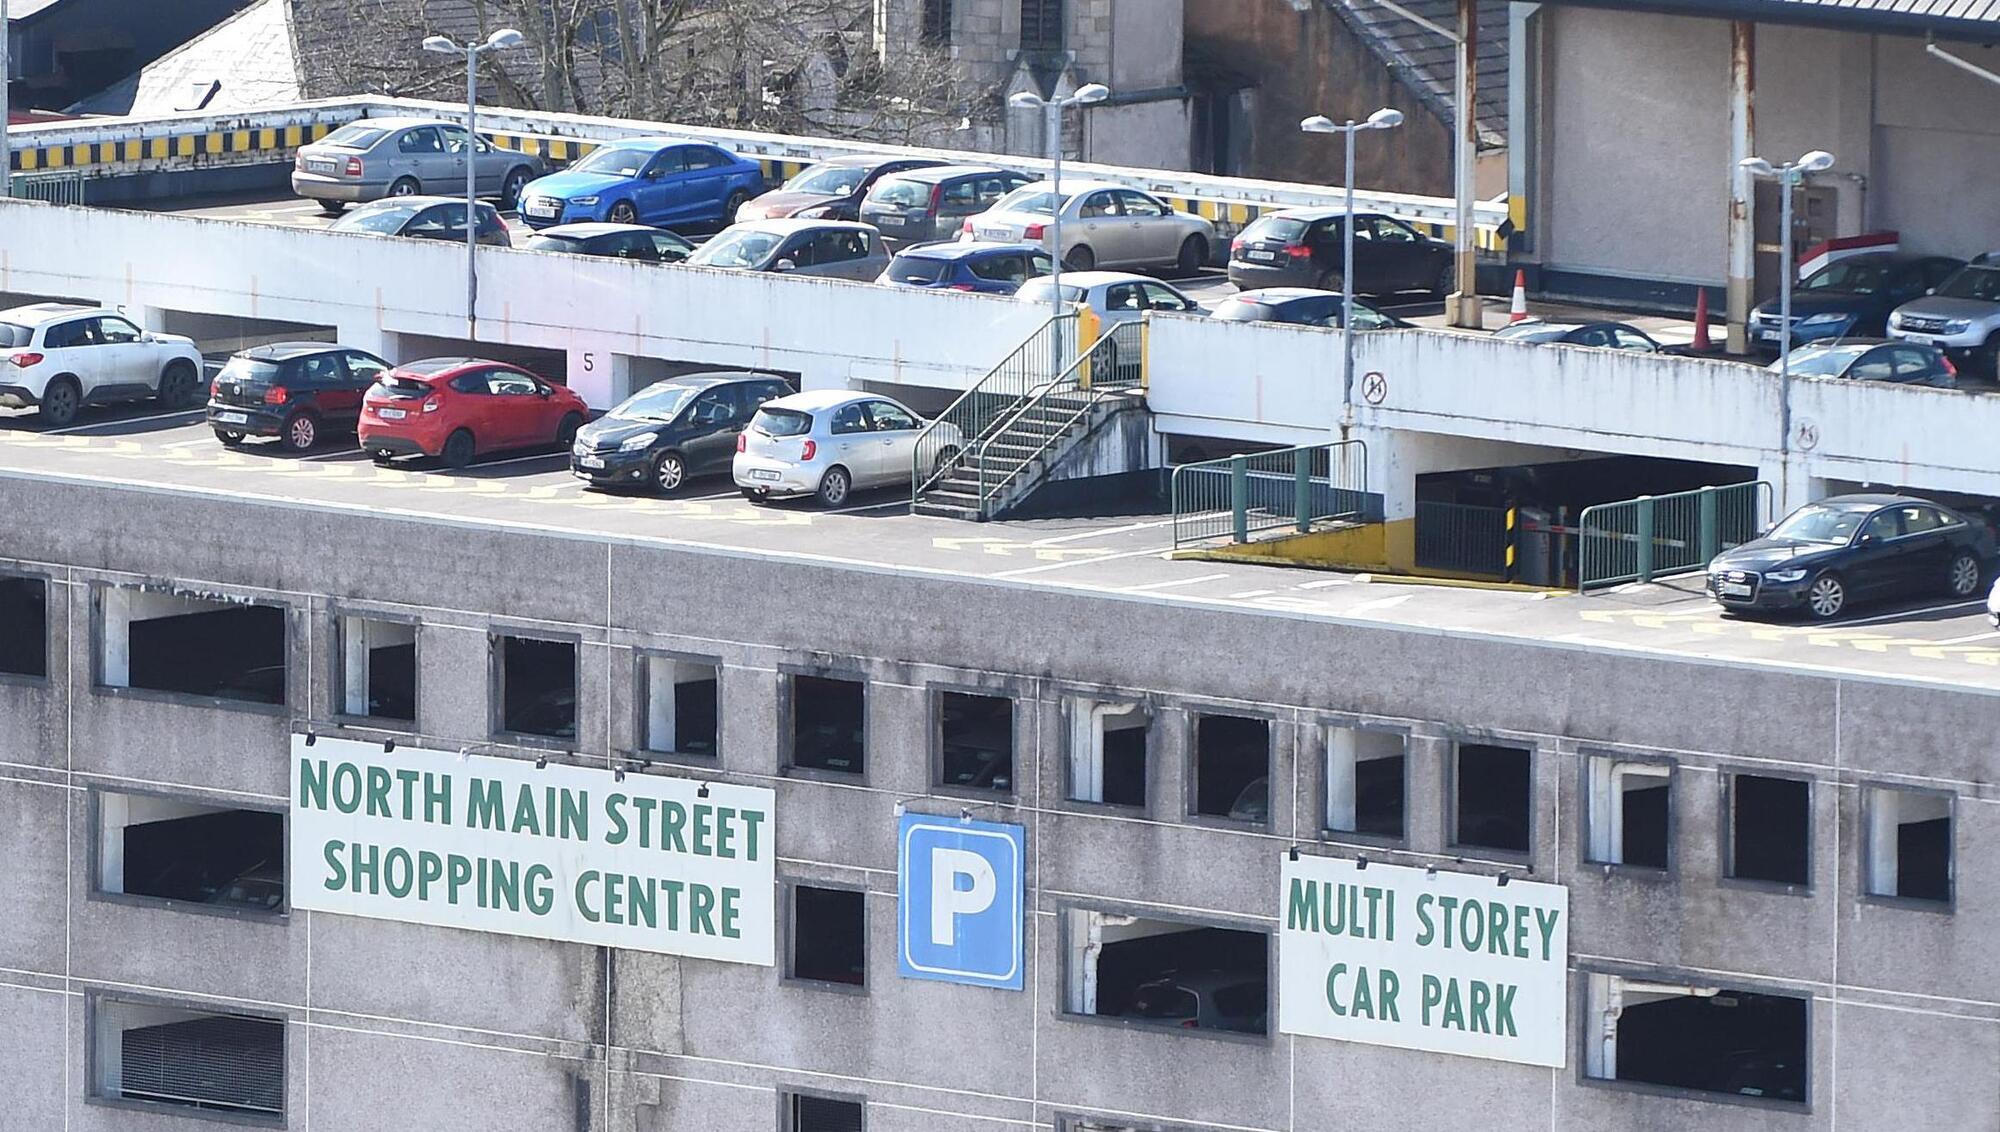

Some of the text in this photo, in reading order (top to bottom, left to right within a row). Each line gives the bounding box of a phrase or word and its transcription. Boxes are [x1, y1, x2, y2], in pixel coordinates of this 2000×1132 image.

[584, 352, 594, 371] 5
[300, 757, 765, 861] NORTH MAIN STREET
[323, 839, 741, 939] SHOPPING CENTRE
[931, 847, 996, 946] P
[1287, 877, 1560, 961] MULTI STOREY
[1325, 963, 1518, 1037] CAR PARK
